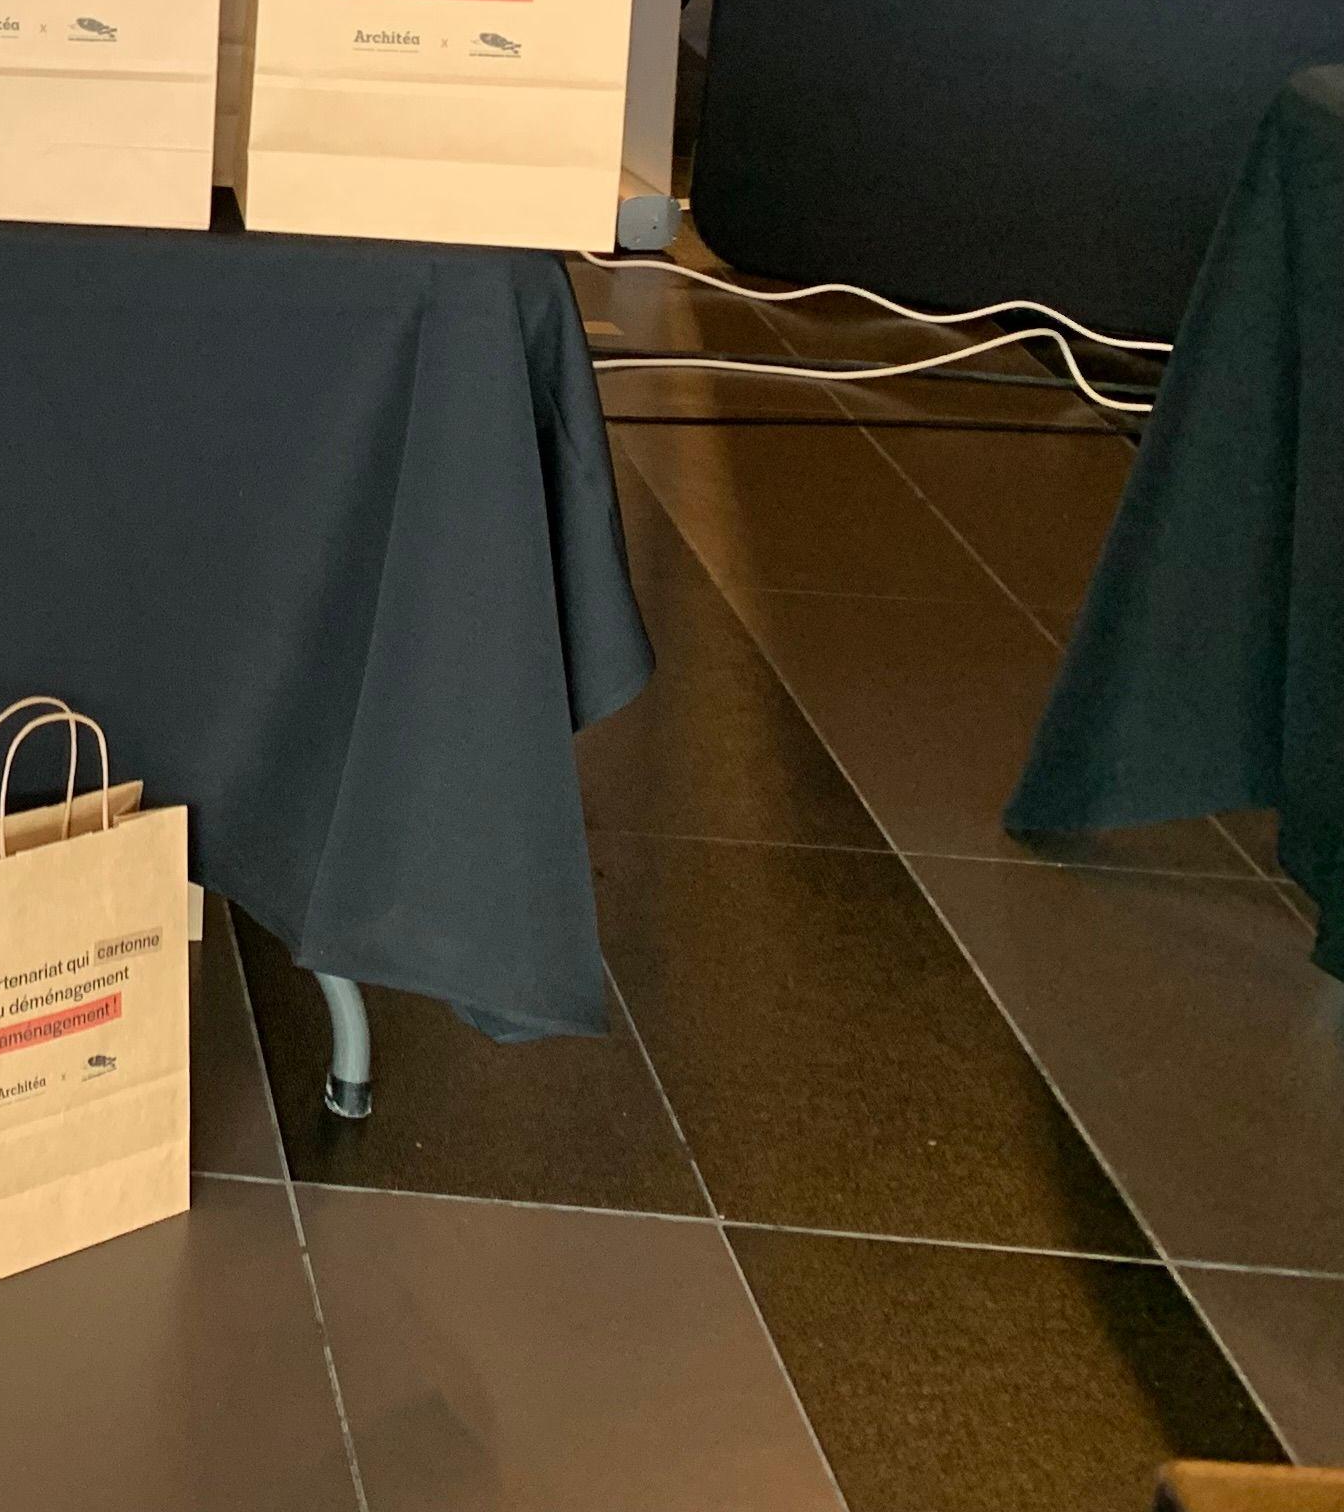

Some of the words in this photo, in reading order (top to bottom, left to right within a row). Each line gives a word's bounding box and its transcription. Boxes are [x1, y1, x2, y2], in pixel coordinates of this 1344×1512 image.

[353, 29, 420, 46] Architéa
[66, 950, 91, 975] qui
[96, 934, 160, 962] cartonne
[8, 967, 130, 1016] déménagement
